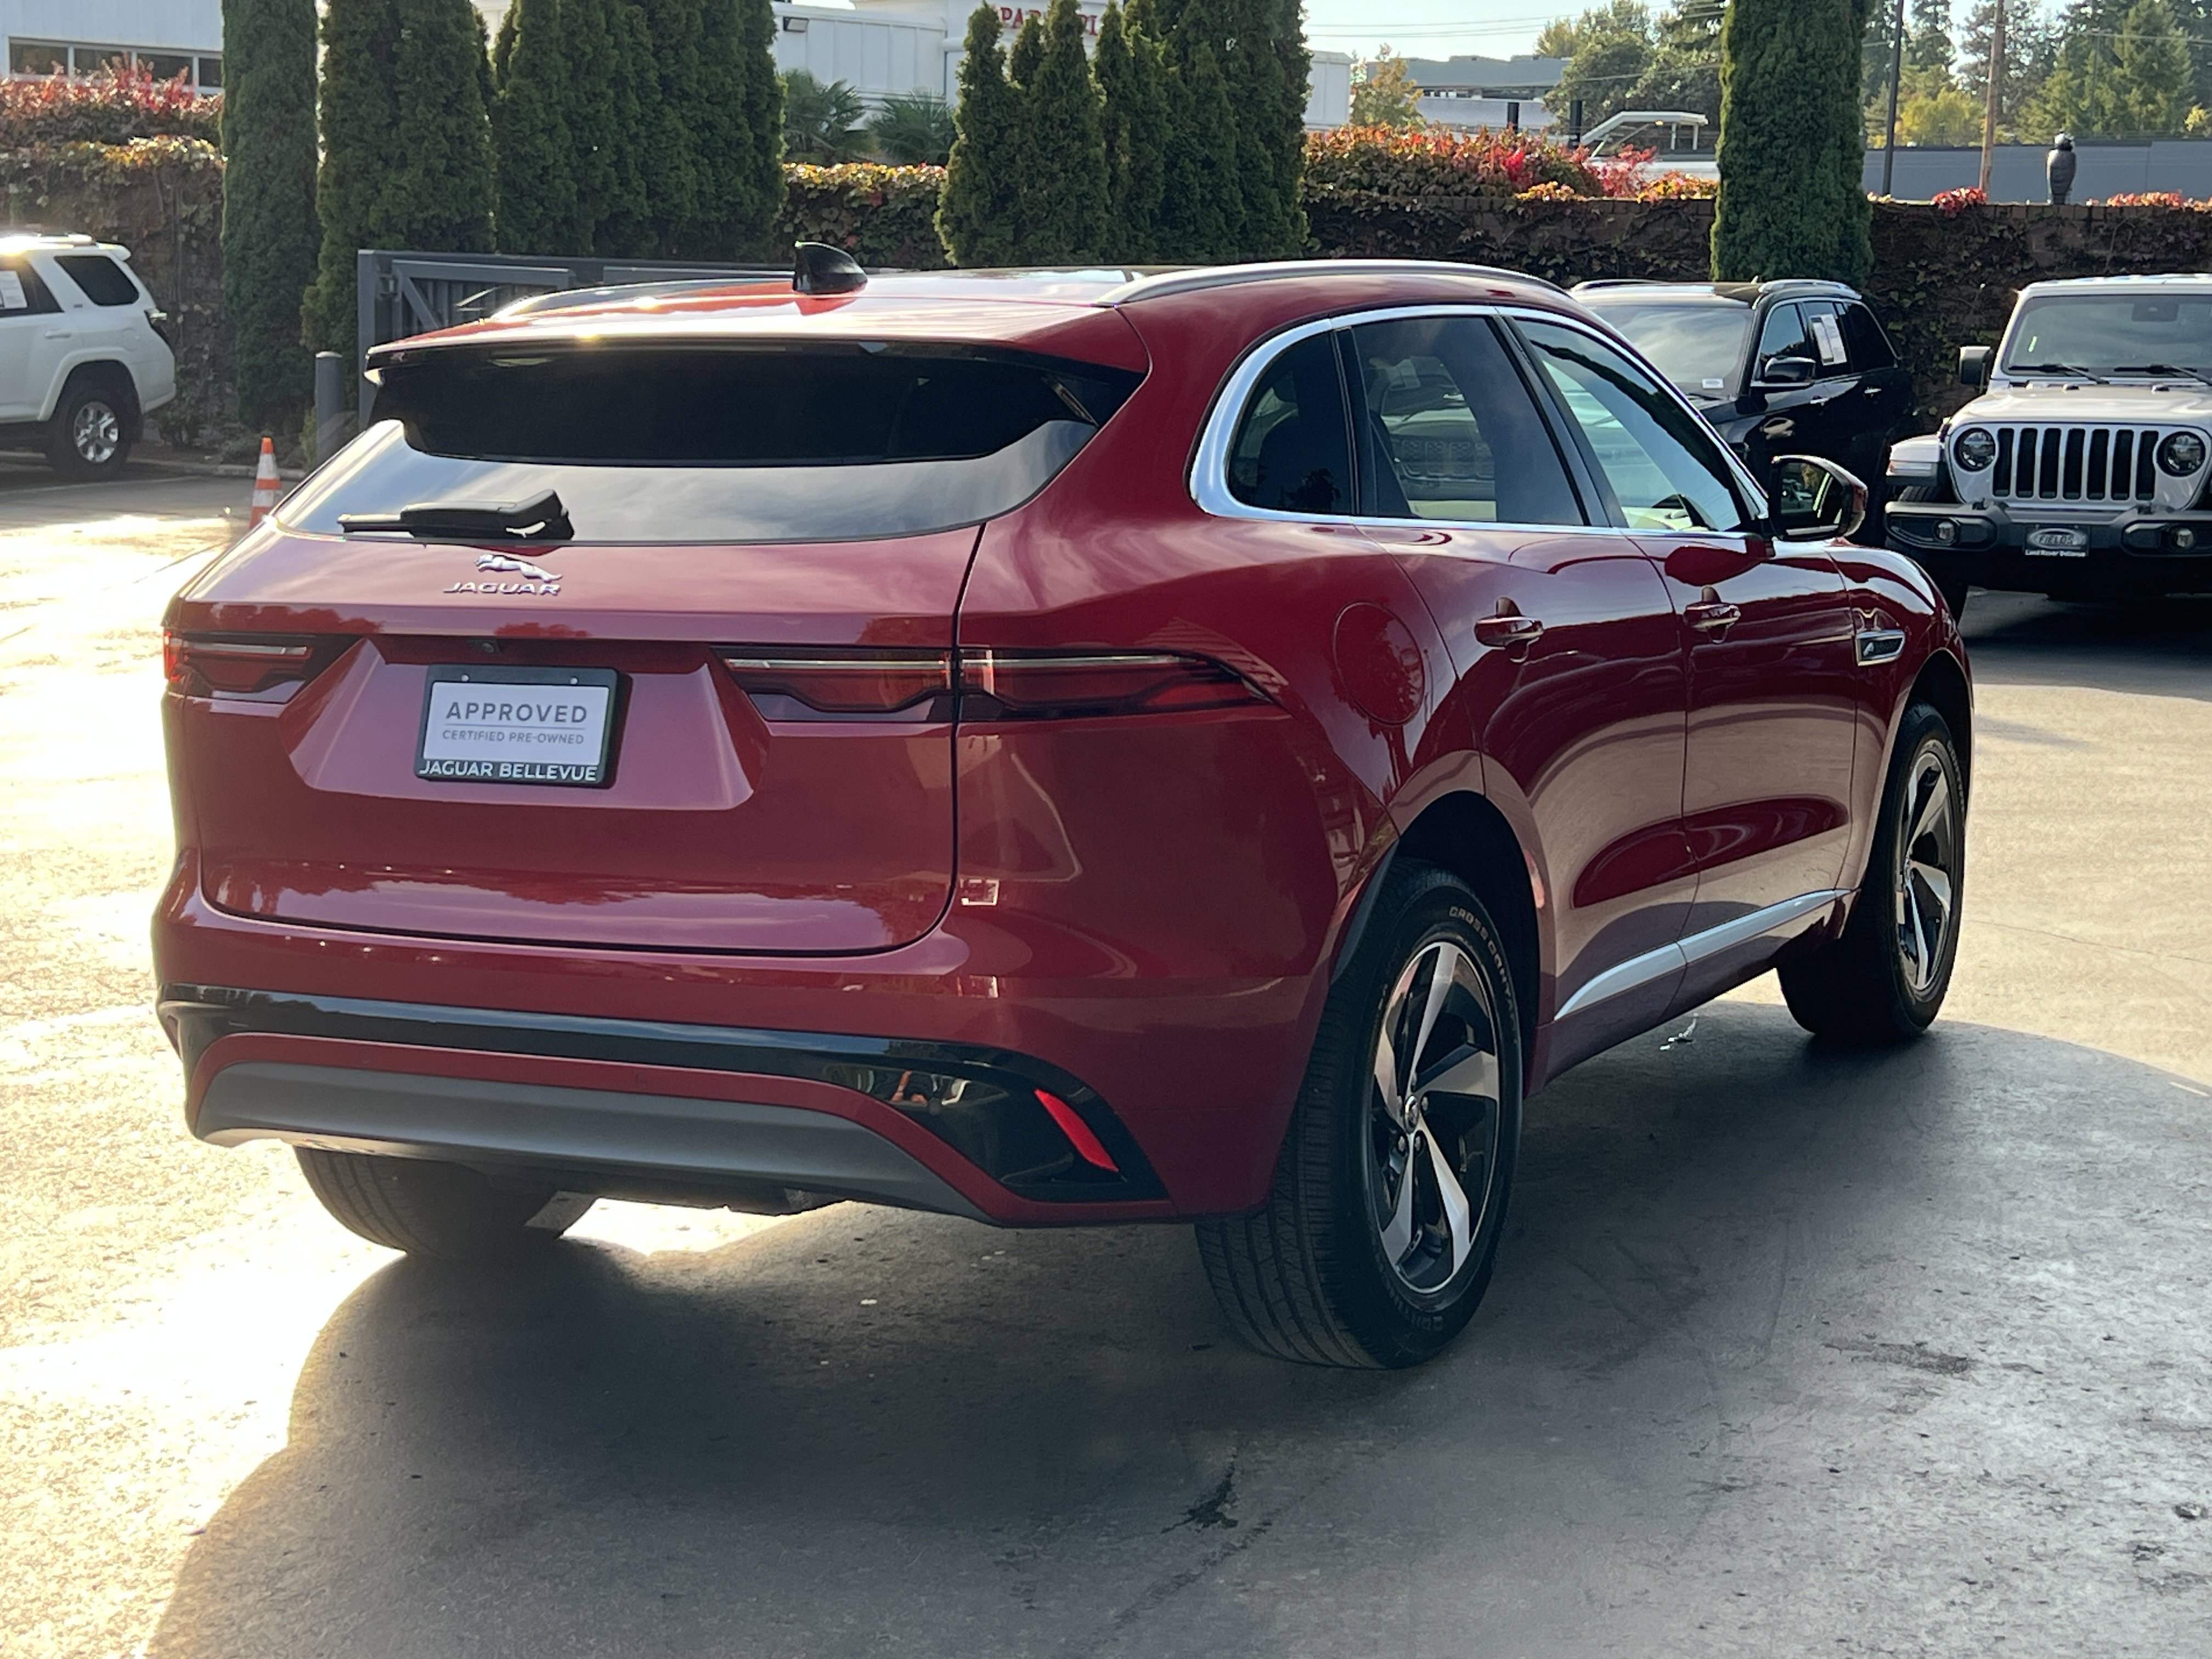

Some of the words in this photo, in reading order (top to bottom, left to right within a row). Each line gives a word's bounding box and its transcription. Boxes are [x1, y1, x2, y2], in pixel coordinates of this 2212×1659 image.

[443, 582, 561, 595] JAGUAR
[446, 702, 587, 723] APPROVED
[443, 730, 505, 742] CERTIFIED
[510, 733, 584, 744] PRE-OWNED
[419, 761, 493, 776] JAGUAR
[499, 763, 597, 781] BELLEVUE
[1449, 906, 1488, 940] CROSS
